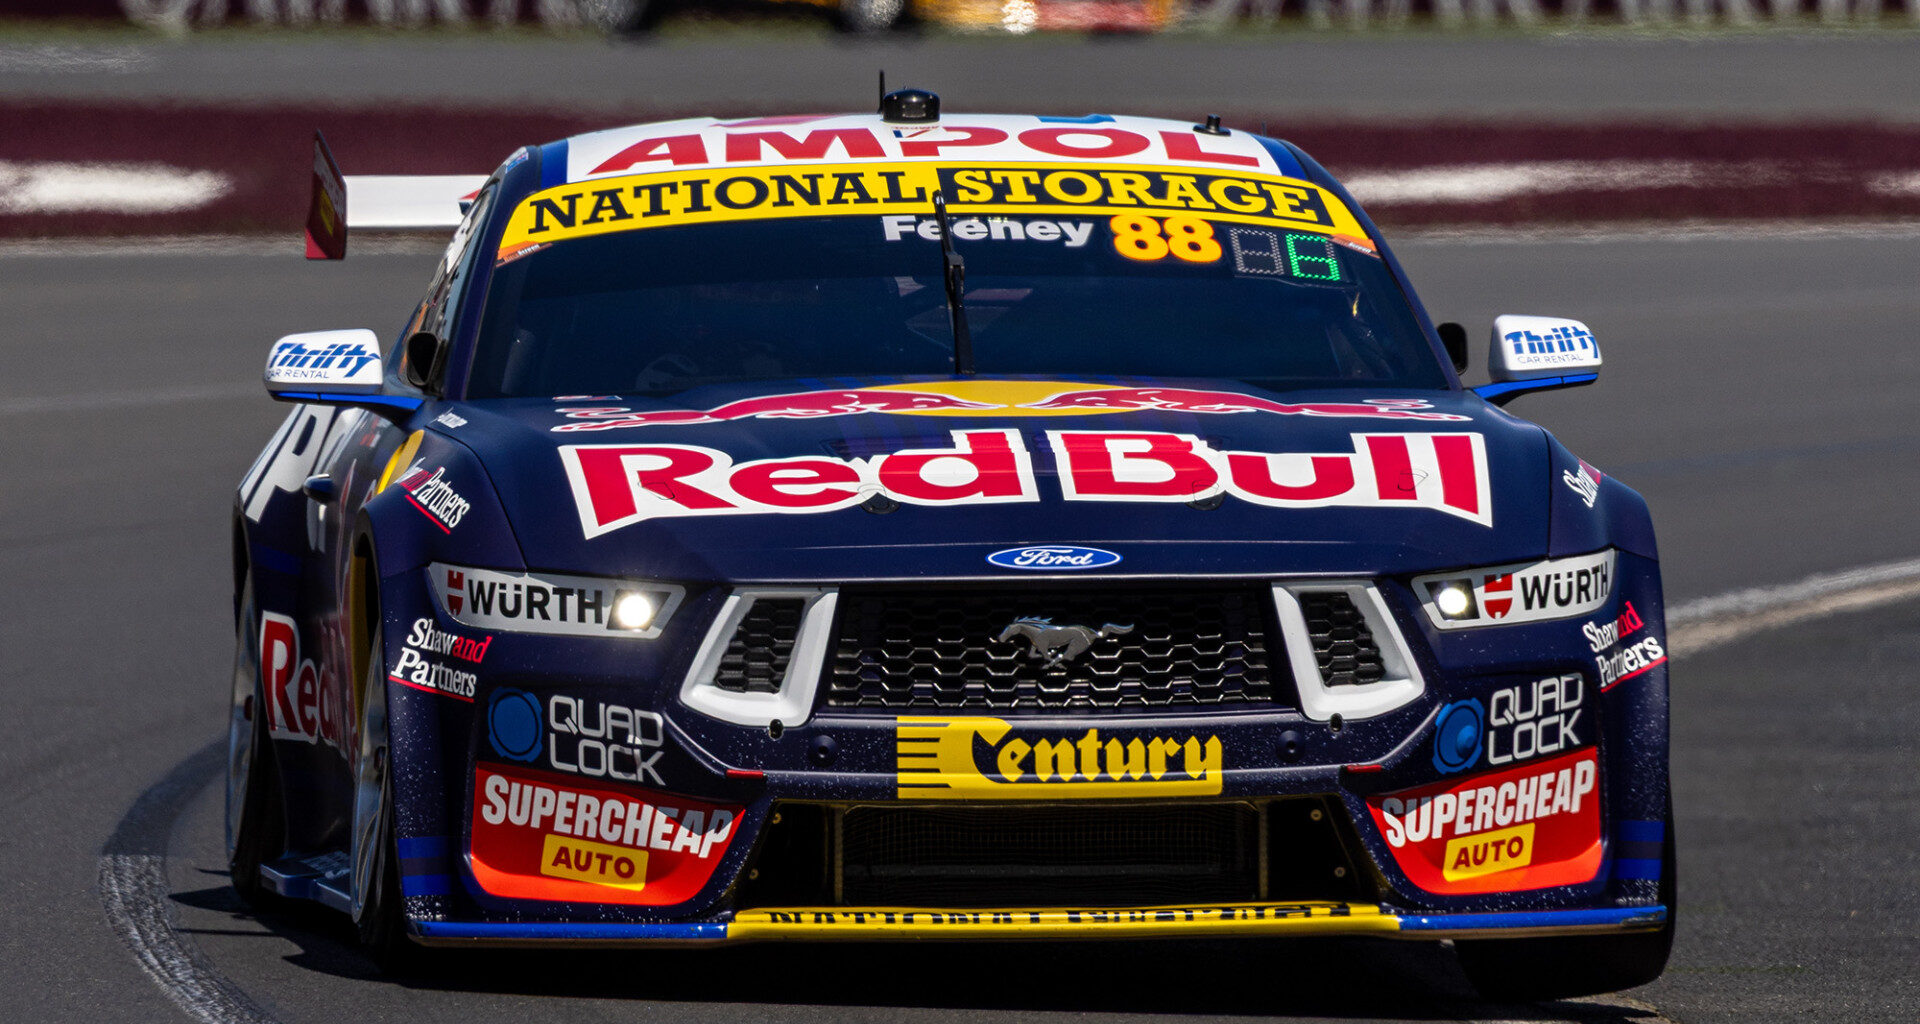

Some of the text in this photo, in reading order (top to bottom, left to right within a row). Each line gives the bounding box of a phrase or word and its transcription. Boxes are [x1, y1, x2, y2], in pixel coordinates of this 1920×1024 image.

[588, 126, 1259, 175] AMPOL
[528, 170, 1318, 234] NATIONAL STORAGE
[882, 214, 1223, 264] Feeney 88
[269, 343, 380, 378] Thrifty
[1505, 326, 1598, 358] Thrifty
[1517, 354, 1583, 364] CAR RENTAL
[284, 369, 330, 379] RENTAL
[411, 466, 471, 529] Partners
[558, 430, 1493, 539] Red Bull
[1014, 549, 1094, 566] Ford
[468, 579, 604, 624] WÜRTH
[1520, 567, 1608, 611] WÜRTH
[390, 647, 476, 698] Partners
[1595, 637, 1664, 688] Partners
[550, 695, 663, 748] QUAD
[1490, 672, 1583, 725] QUAD
[550, 733, 666, 786] LOCK
[897, 716, 1222, 799] Century
[1488, 708, 1582, 765] LOCK
[481, 774, 733, 858] SUPERCHEAP
[1382, 759, 1596, 848] SUPERCHEAP
[551, 846, 636, 879] AUTO
[1452, 835, 1524, 870] AUTO
